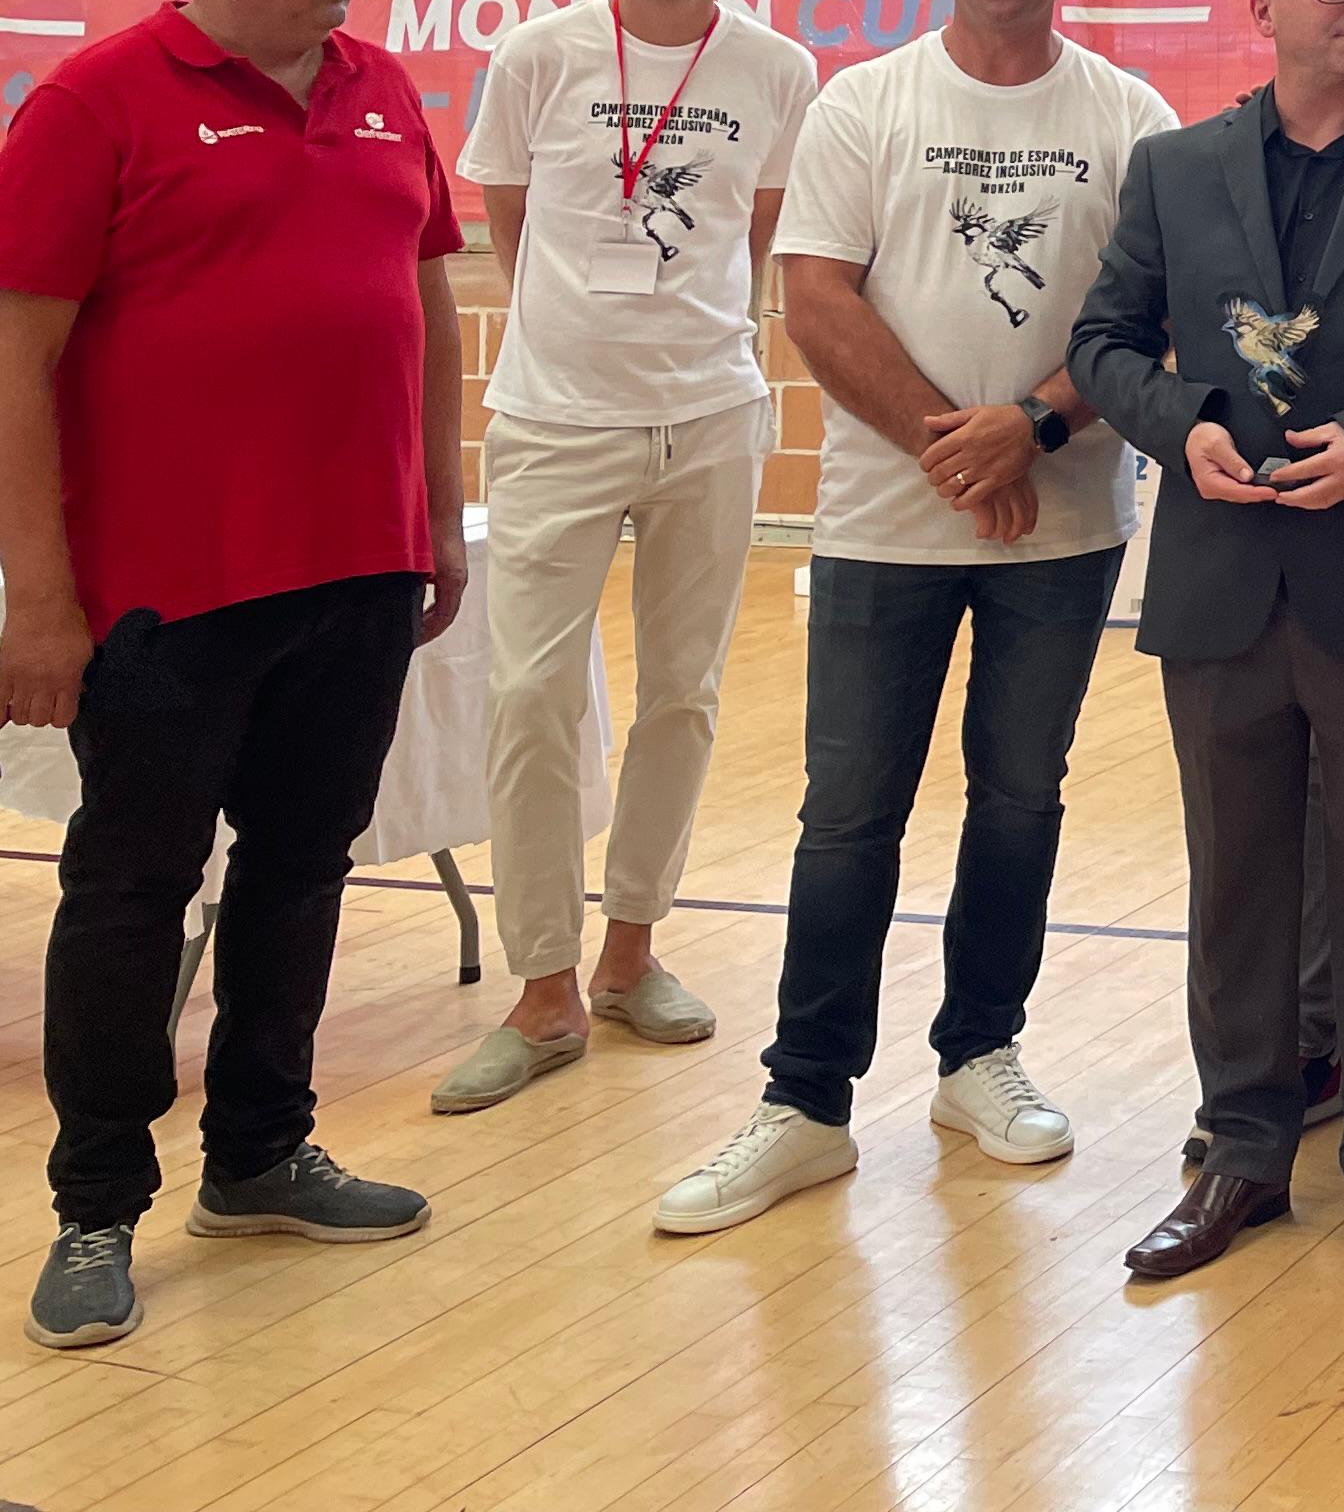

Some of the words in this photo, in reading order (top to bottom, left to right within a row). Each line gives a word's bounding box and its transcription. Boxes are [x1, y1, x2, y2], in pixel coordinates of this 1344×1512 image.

[606, 117, 654, 130] AJDREZ
[670, 105, 683, 118] DE
[687, 106, 728, 126] ESPAÑA
[727, 119, 741, 142] 2
[642, 133, 684, 145] MNZÓN
[925, 146, 1005, 164] CAMPEONATO
[1009, 150, 1023, 163] DE
[1028, 149, 1074, 167] ESPAÑA
[1075, 159, 1089, 183] 2
[942, 161, 992, 179] AJEDREZ
[995, 163, 1056, 178] INCLUSIVO
[980, 180, 1025, 194] MONZÓN
